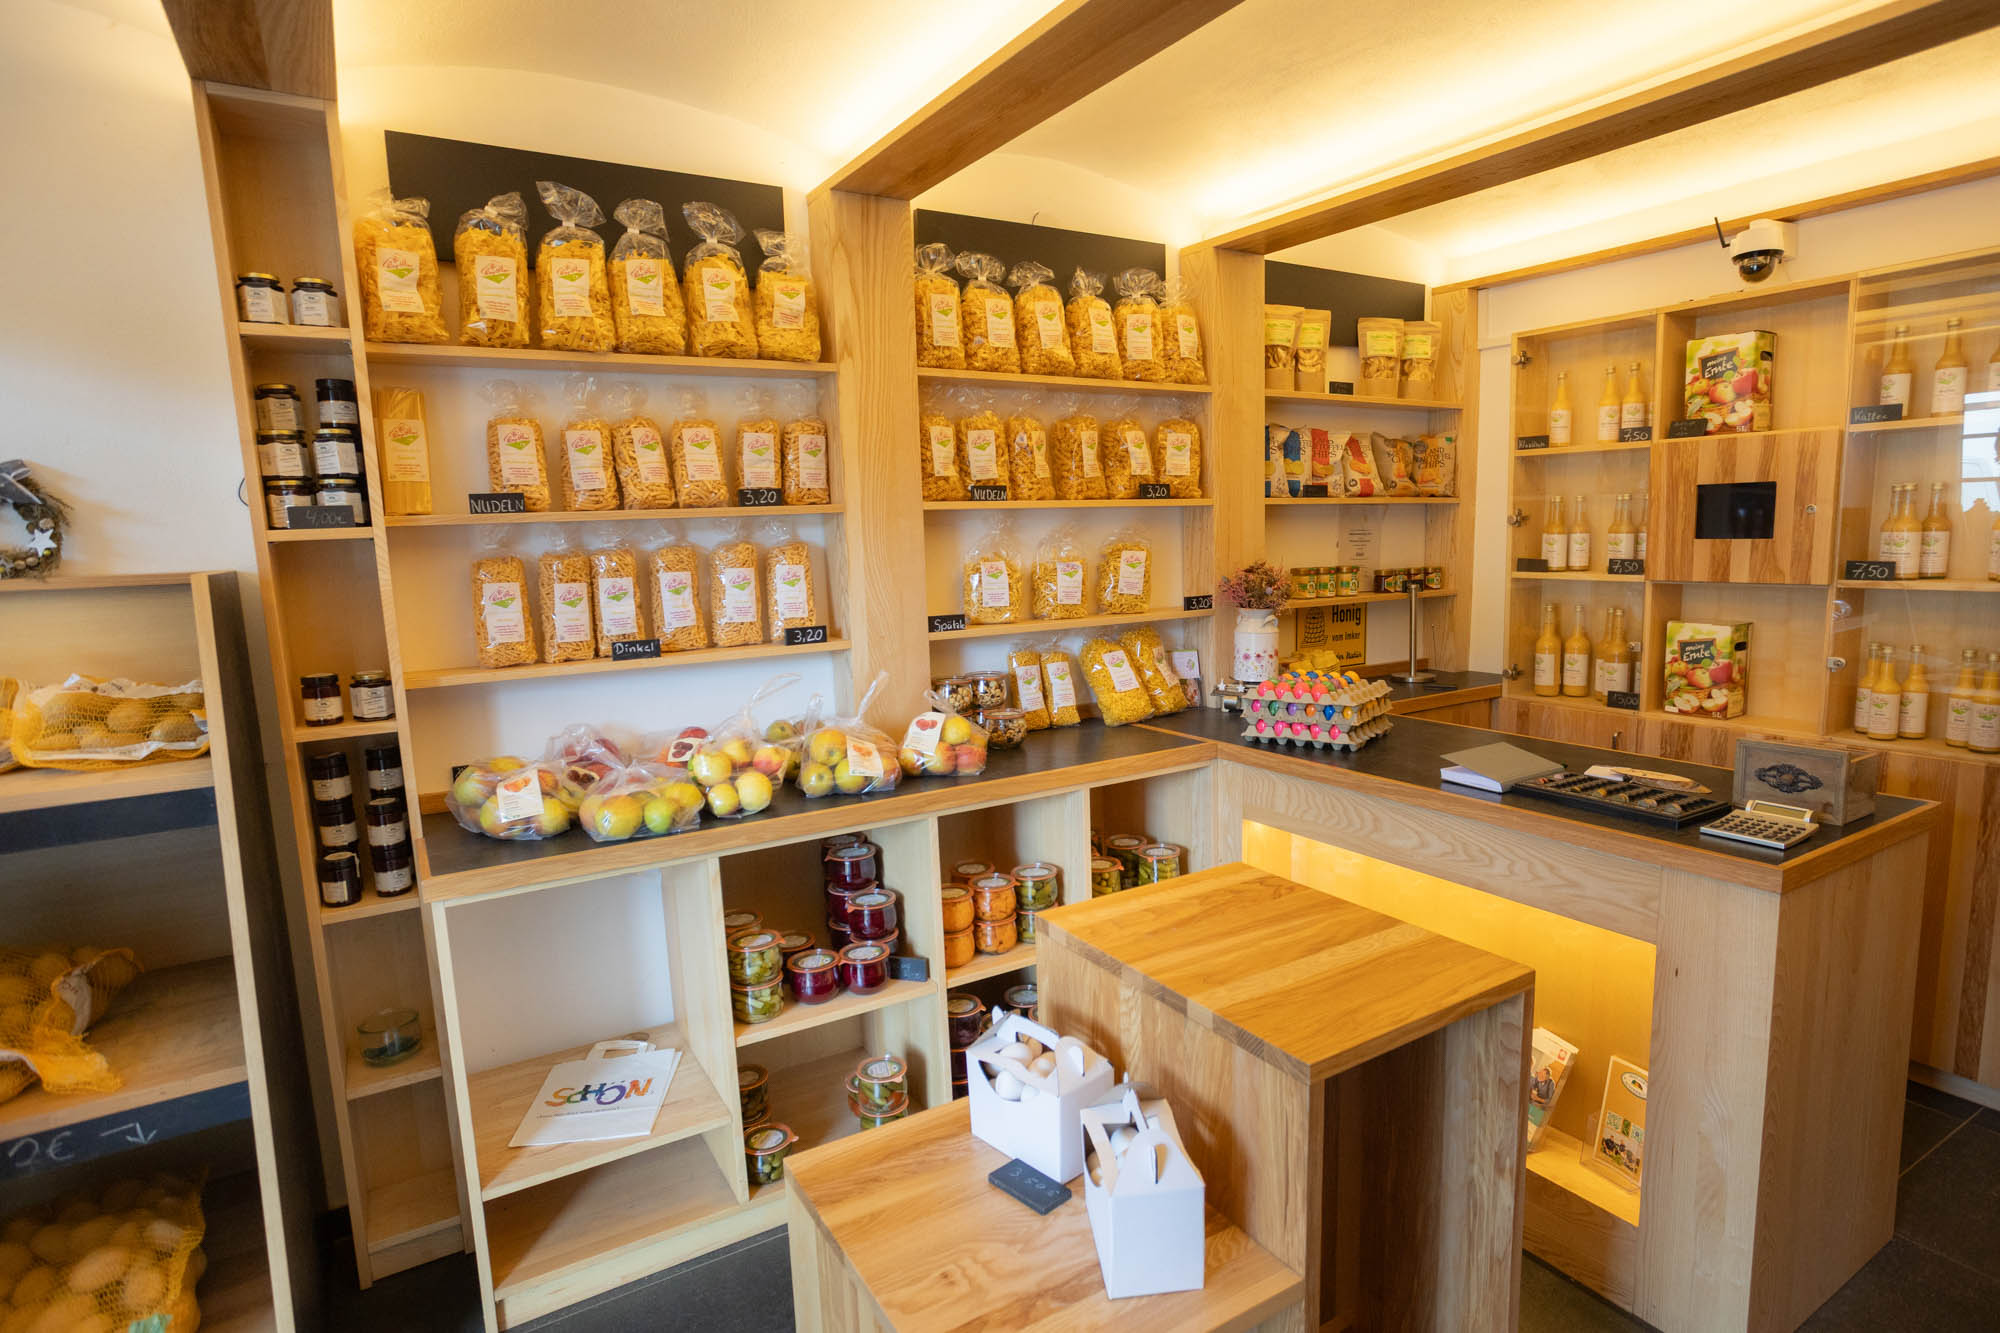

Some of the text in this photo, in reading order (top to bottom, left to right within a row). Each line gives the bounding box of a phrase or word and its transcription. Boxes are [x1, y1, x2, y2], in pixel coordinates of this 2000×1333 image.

[1704, 359, 1734, 379] Ernte
[1623, 428, 1649, 442] 7,50
[974, 487, 1007, 501] NUDELN
[1147, 485, 1167, 498] 3,20
[470, 498, 525, 513] NUDELN
[1612, 559, 1639, 574] 7,50
[1852, 562, 1889, 579] 7,50
[1332, 604, 1361, 626] Honig
[614, 642, 655, 655] Dinkel
[1682, 648, 1711, 662] Ernte
